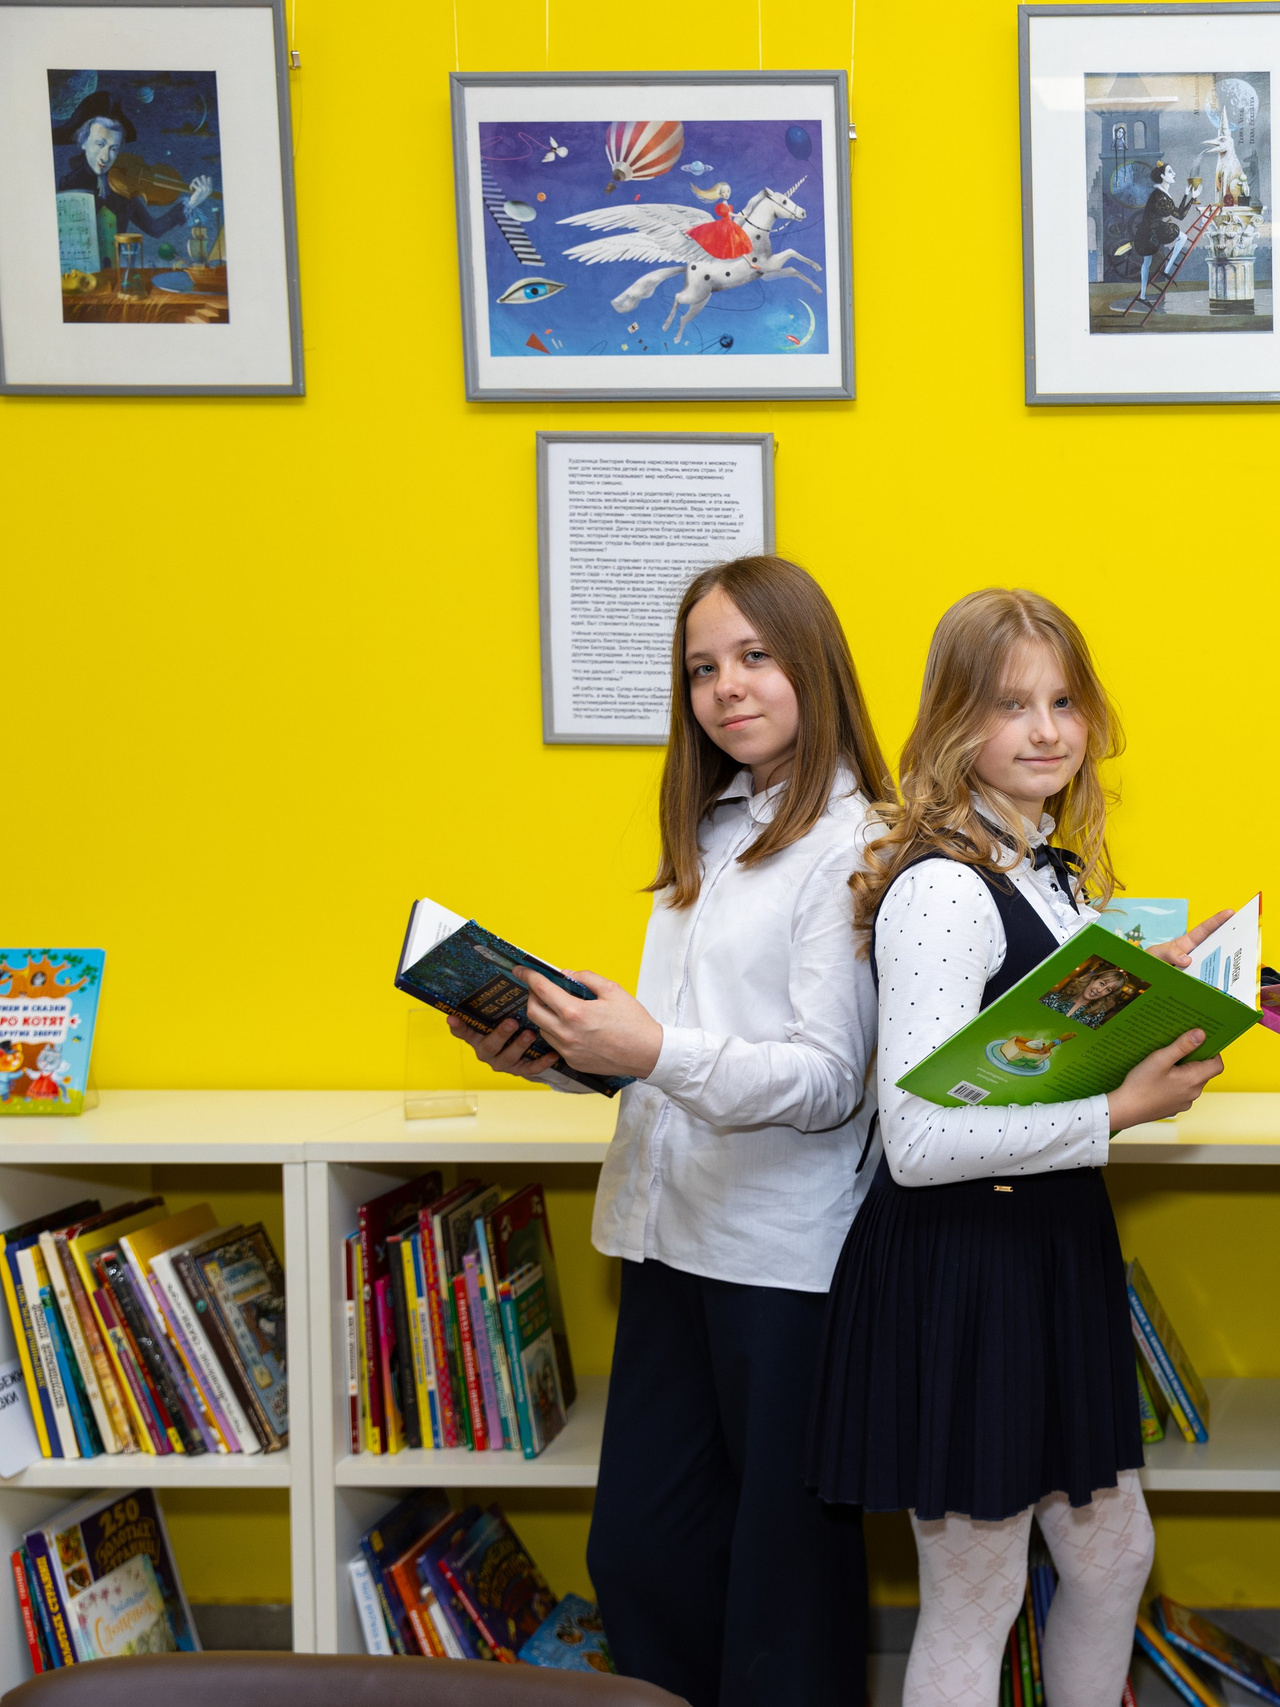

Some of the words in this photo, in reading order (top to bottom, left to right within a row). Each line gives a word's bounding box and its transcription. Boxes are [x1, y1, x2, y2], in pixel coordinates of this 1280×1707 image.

[472, 979, 510, 1010] ЗЕМЛЯНИКА
[481, 998, 500, 1016] ПОД
[497, 986, 524, 1008] СНЕГОМ
[22, 1016, 65, 1026] КОТЯТ
[98, 1496, 140, 1535] 250
[100, 1520, 155, 1557] ЗОЛОТЫХ
[35, 1554, 60, 1613] СТРАНИЦ
